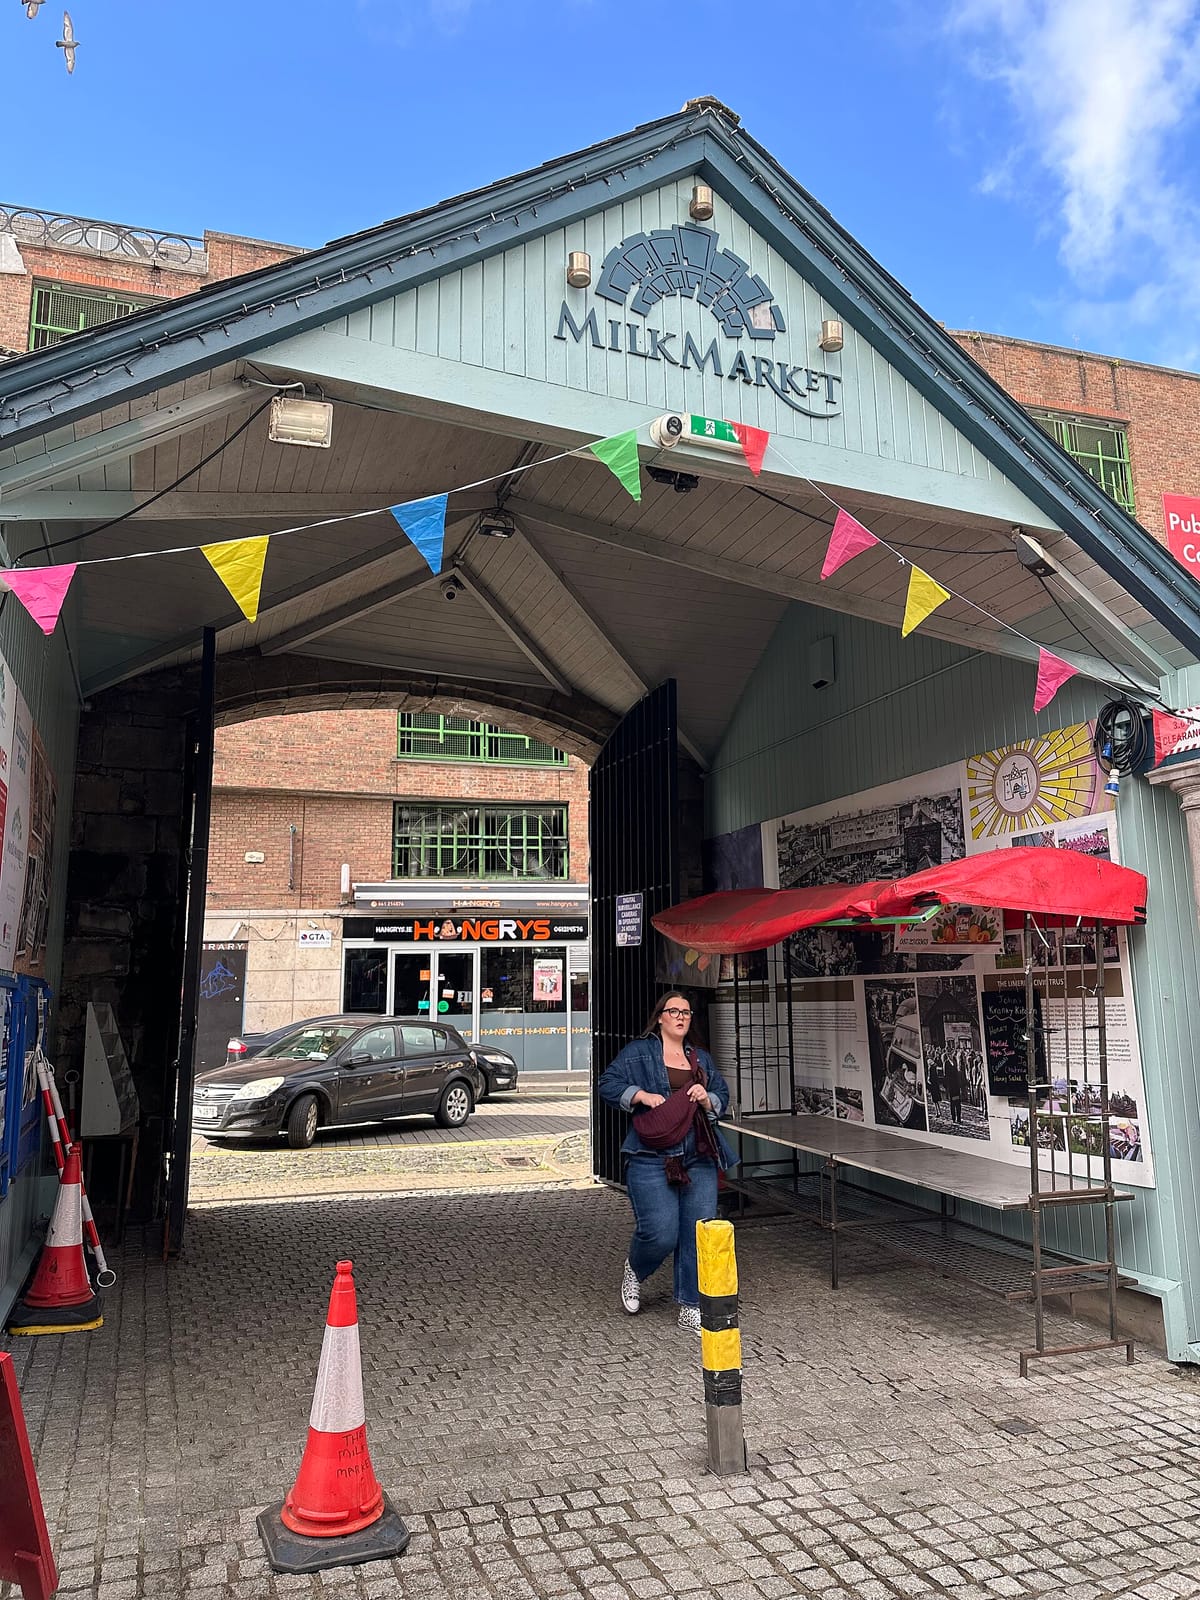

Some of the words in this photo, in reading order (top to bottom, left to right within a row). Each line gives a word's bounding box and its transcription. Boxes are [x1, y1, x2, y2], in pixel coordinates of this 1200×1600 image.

[1162, 727, 1200, 746] CLEARAN
[309, 933, 325, 941] GTA
[1049, 978, 1064, 986] TRUS
[336, 1457, 371, 1479] MARKE
